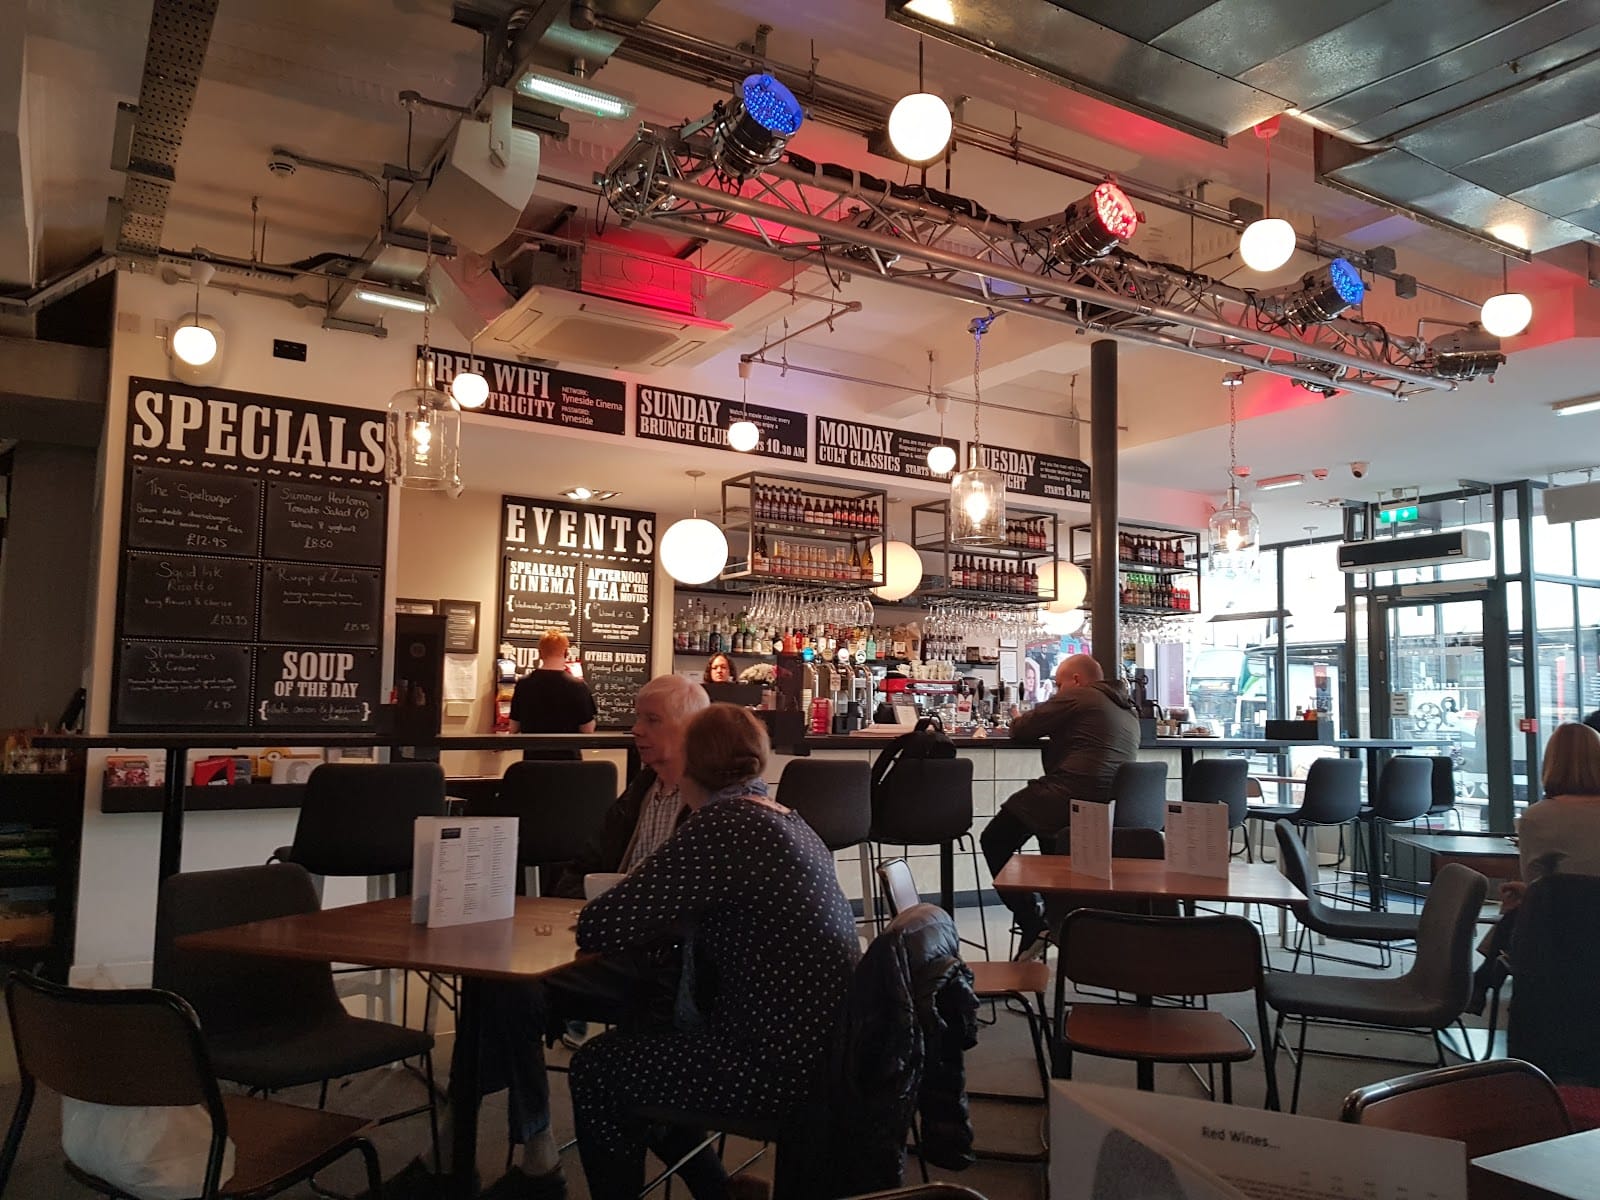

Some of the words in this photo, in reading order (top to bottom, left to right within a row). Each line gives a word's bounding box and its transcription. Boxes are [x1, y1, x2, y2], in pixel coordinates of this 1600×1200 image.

[493, 363, 550, 399] WIFI
[562, 393, 594, 407] Tyneside
[596, 399, 623, 411] Cinema
[641, 388, 721, 427] SUNDAY
[561, 413, 594, 425] tyneside
[640, 416, 695, 441] BRUNCH
[133, 390, 386, 474] SPECIALS
[820, 420, 894, 454] MONDAY
[767, 438, 791, 455] 10.30
[793, 446, 805, 457] AM
[819, 448, 847, 464] CULT
[850, 452, 900, 472] CLASSICS
[905, 463, 929, 476] STARTS
[981, 448, 1036, 476] UESDAY
[146, 477, 168, 495] The
[280, 488, 322, 501] Summer
[1044, 485, 1065, 496] STARTS
[1066, 484, 1080, 499] 8.30
[323, 505, 351, 517] Salad
[505, 503, 653, 555] EVENTS
[156, 561, 196, 583] Squid
[510, 560, 576, 579] SPEAKEASY
[587, 567, 648, 585] AFTERNOON
[509, 575, 575, 595] CINEMA
[587, 580, 619, 601] TEA
[620, 583, 631, 593] AT
[633, 584, 648, 594] THE
[620, 593, 648, 604] MOVIES
[282, 651, 354, 681] SOUP
[585, 651, 613, 662] OTHER
[615, 652, 646, 664] EVENTS
[274, 681, 294, 697] OF
[297, 681, 327, 697] THE
[330, 683, 359, 698] DAY
[1202, 1126, 1225, 1141] Red
